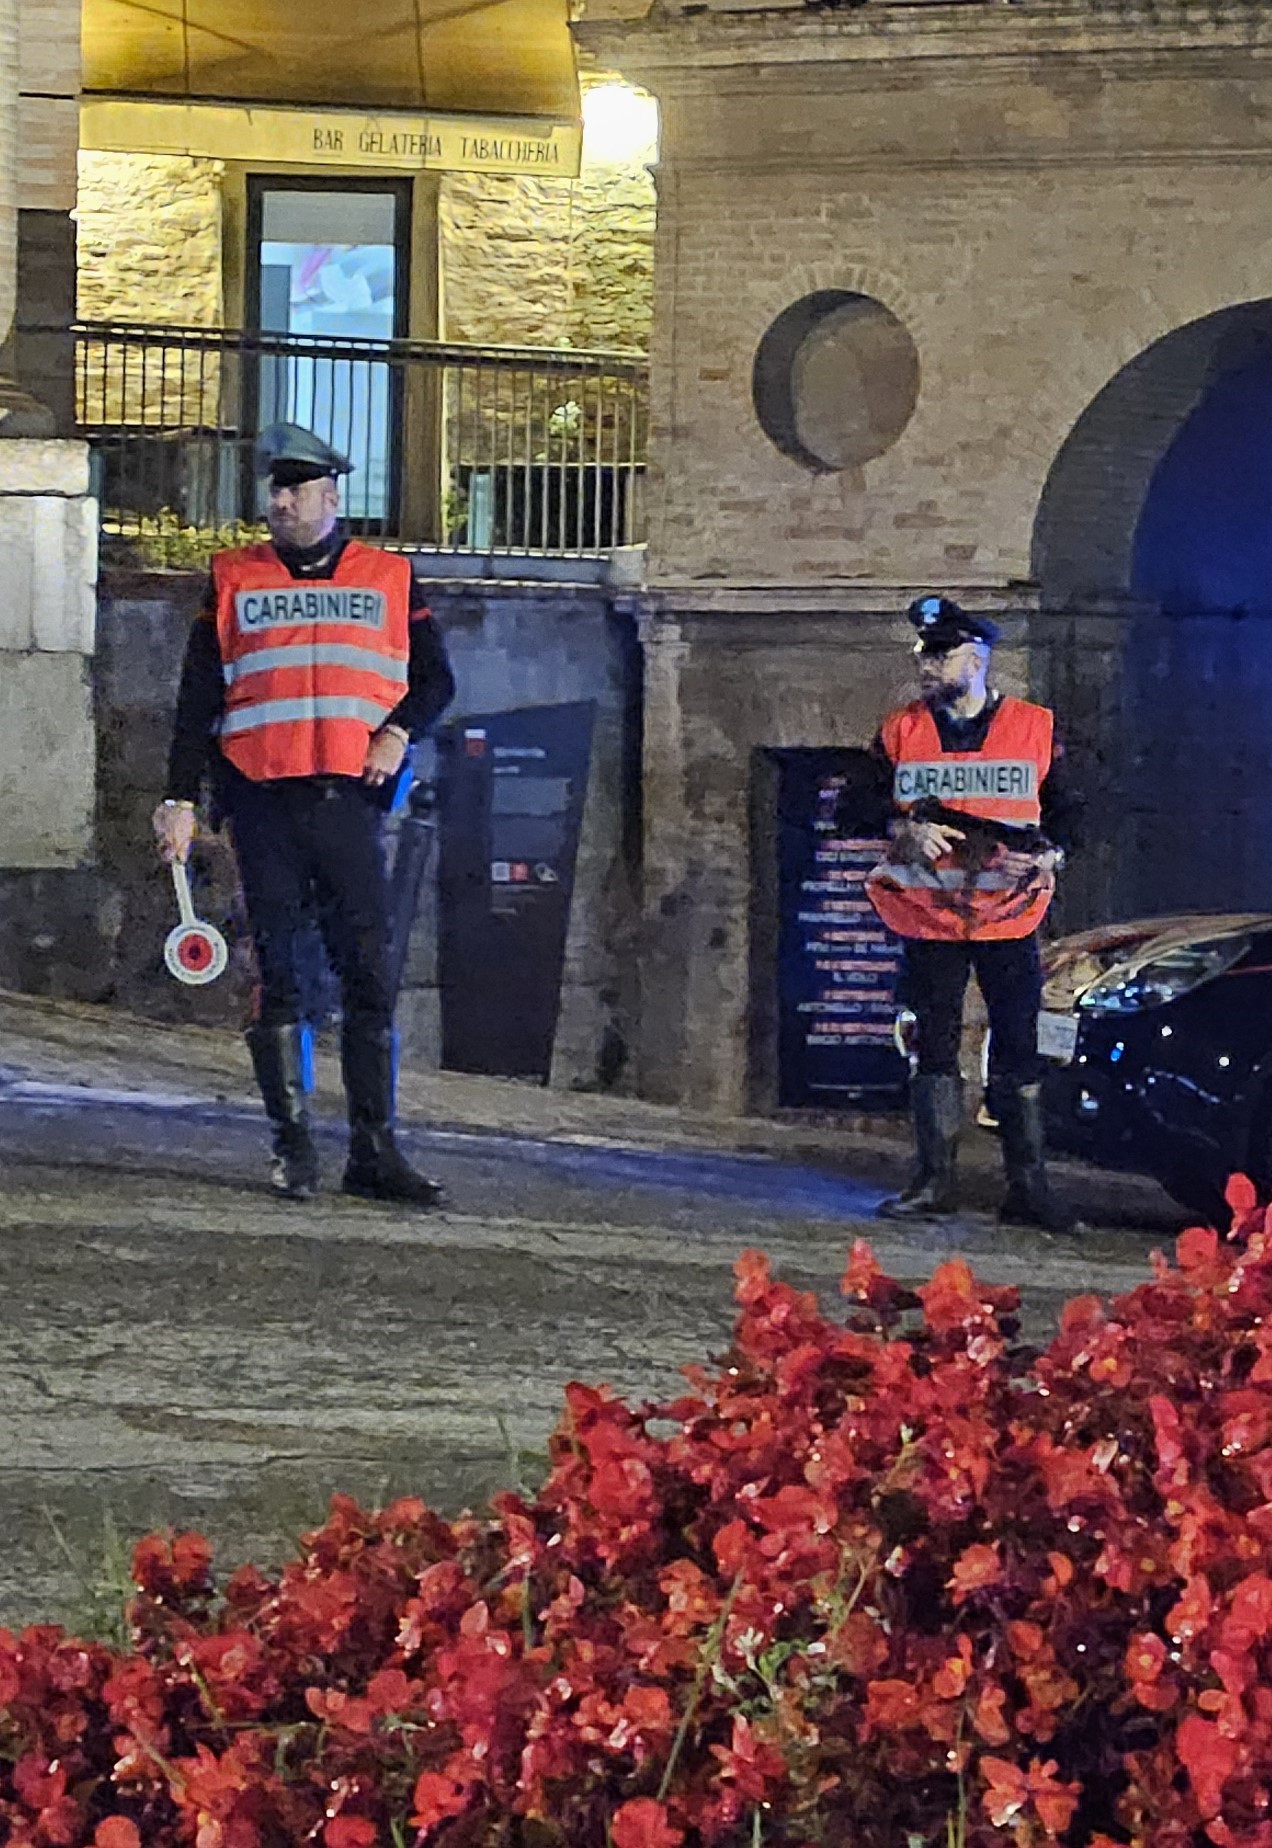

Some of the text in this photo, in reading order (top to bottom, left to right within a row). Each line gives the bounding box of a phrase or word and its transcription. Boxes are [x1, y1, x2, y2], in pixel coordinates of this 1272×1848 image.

[313, 128, 559, 164] BAR GELATERIA TABACCHERIA
[243, 592, 382, 625] CARABINIERI
[898, 766, 1030, 795] CARABINIERI
